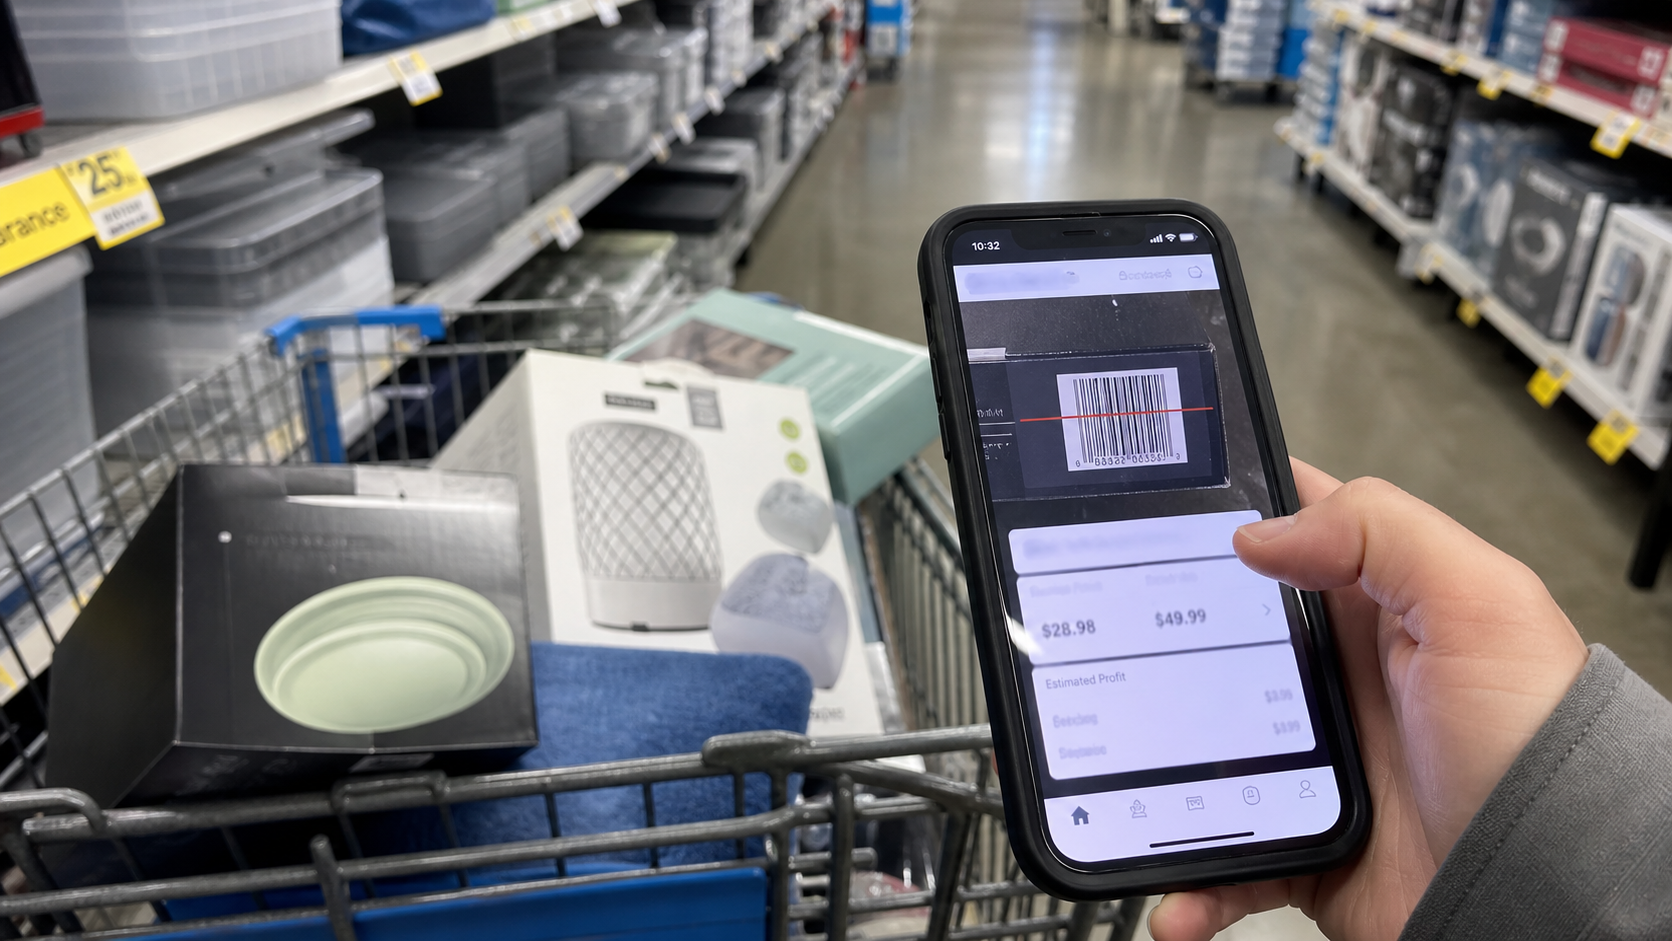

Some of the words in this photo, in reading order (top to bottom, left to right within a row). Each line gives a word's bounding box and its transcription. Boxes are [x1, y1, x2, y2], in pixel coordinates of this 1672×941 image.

[79, 155, 122, 195] 25
[972, 241, 1000, 251] 10:32
[1155, 609, 1206, 628] $49.99
[1042, 619, 1096, 639] $28.98
[1046, 674, 1096, 690] Estimated
[1098, 671, 1126, 684] Profit
